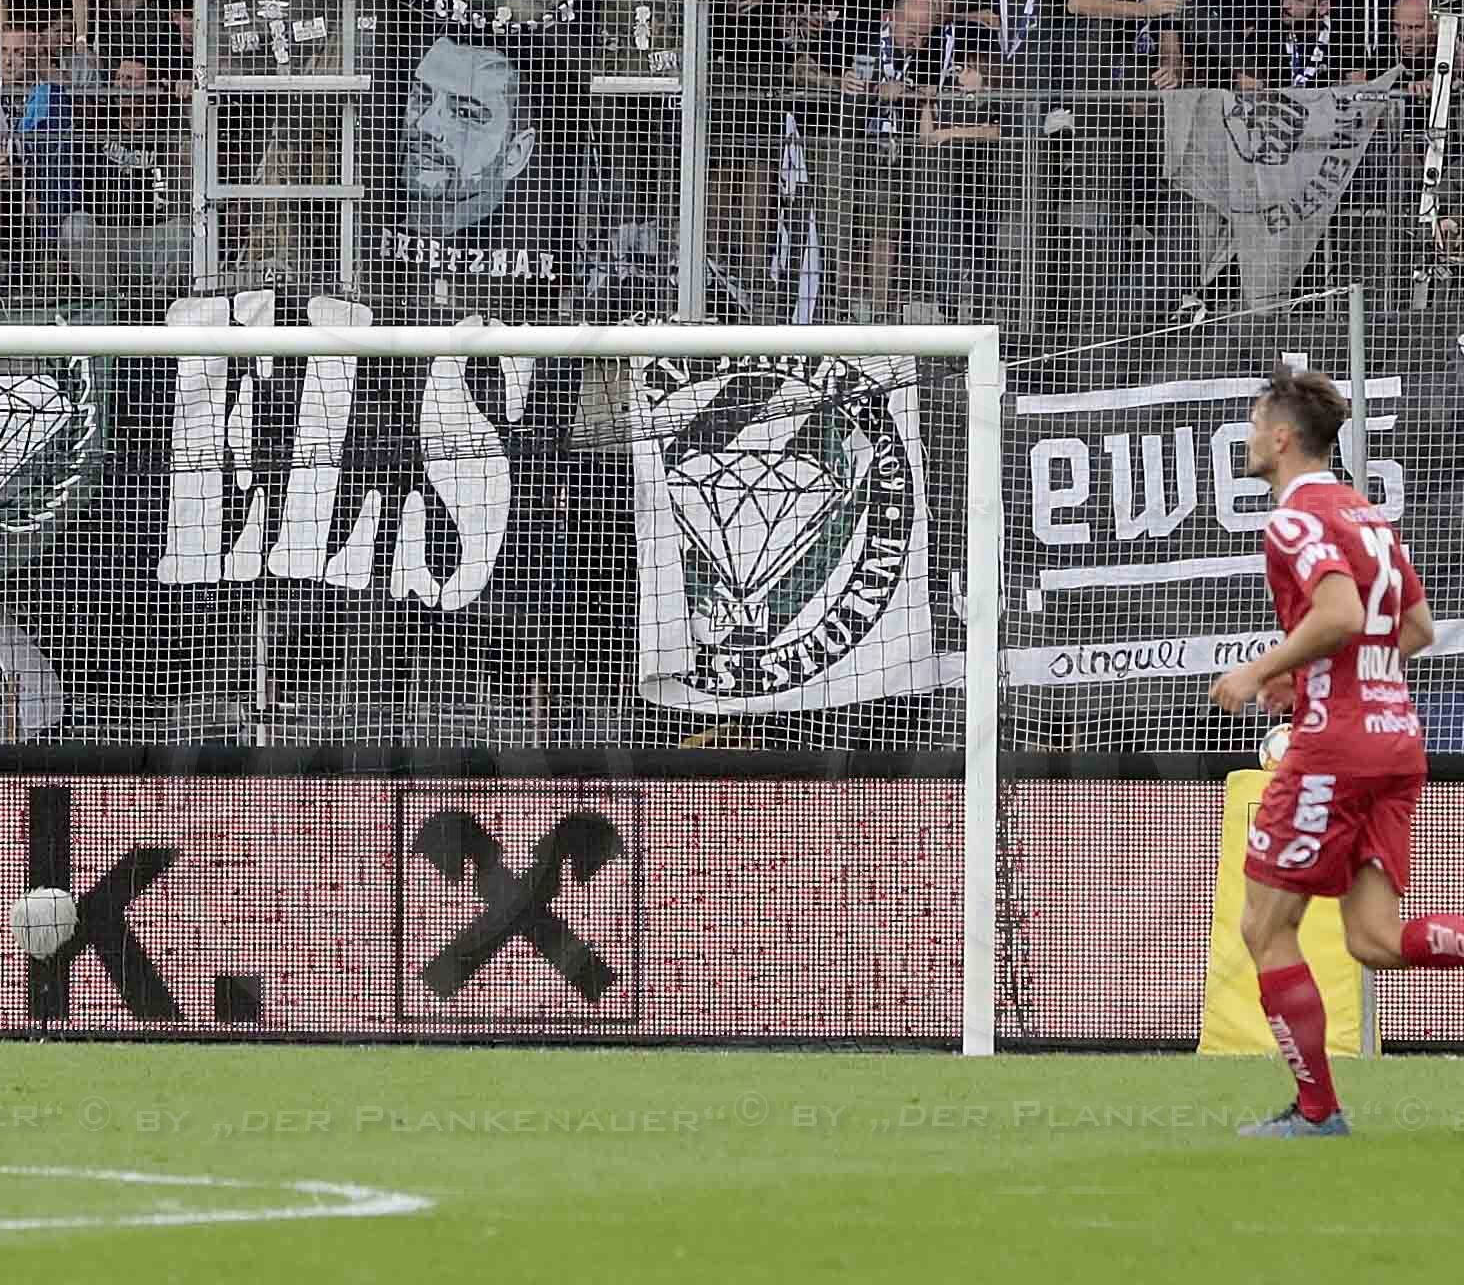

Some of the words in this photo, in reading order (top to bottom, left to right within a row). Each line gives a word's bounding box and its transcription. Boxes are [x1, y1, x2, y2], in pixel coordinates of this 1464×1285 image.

[377, 226, 558, 282] ERSETZBAR
[759, 533, 908, 691] STURM
[1360, 527, 1405, 637] 25
[1048, 635, 1186, 679] singuli
